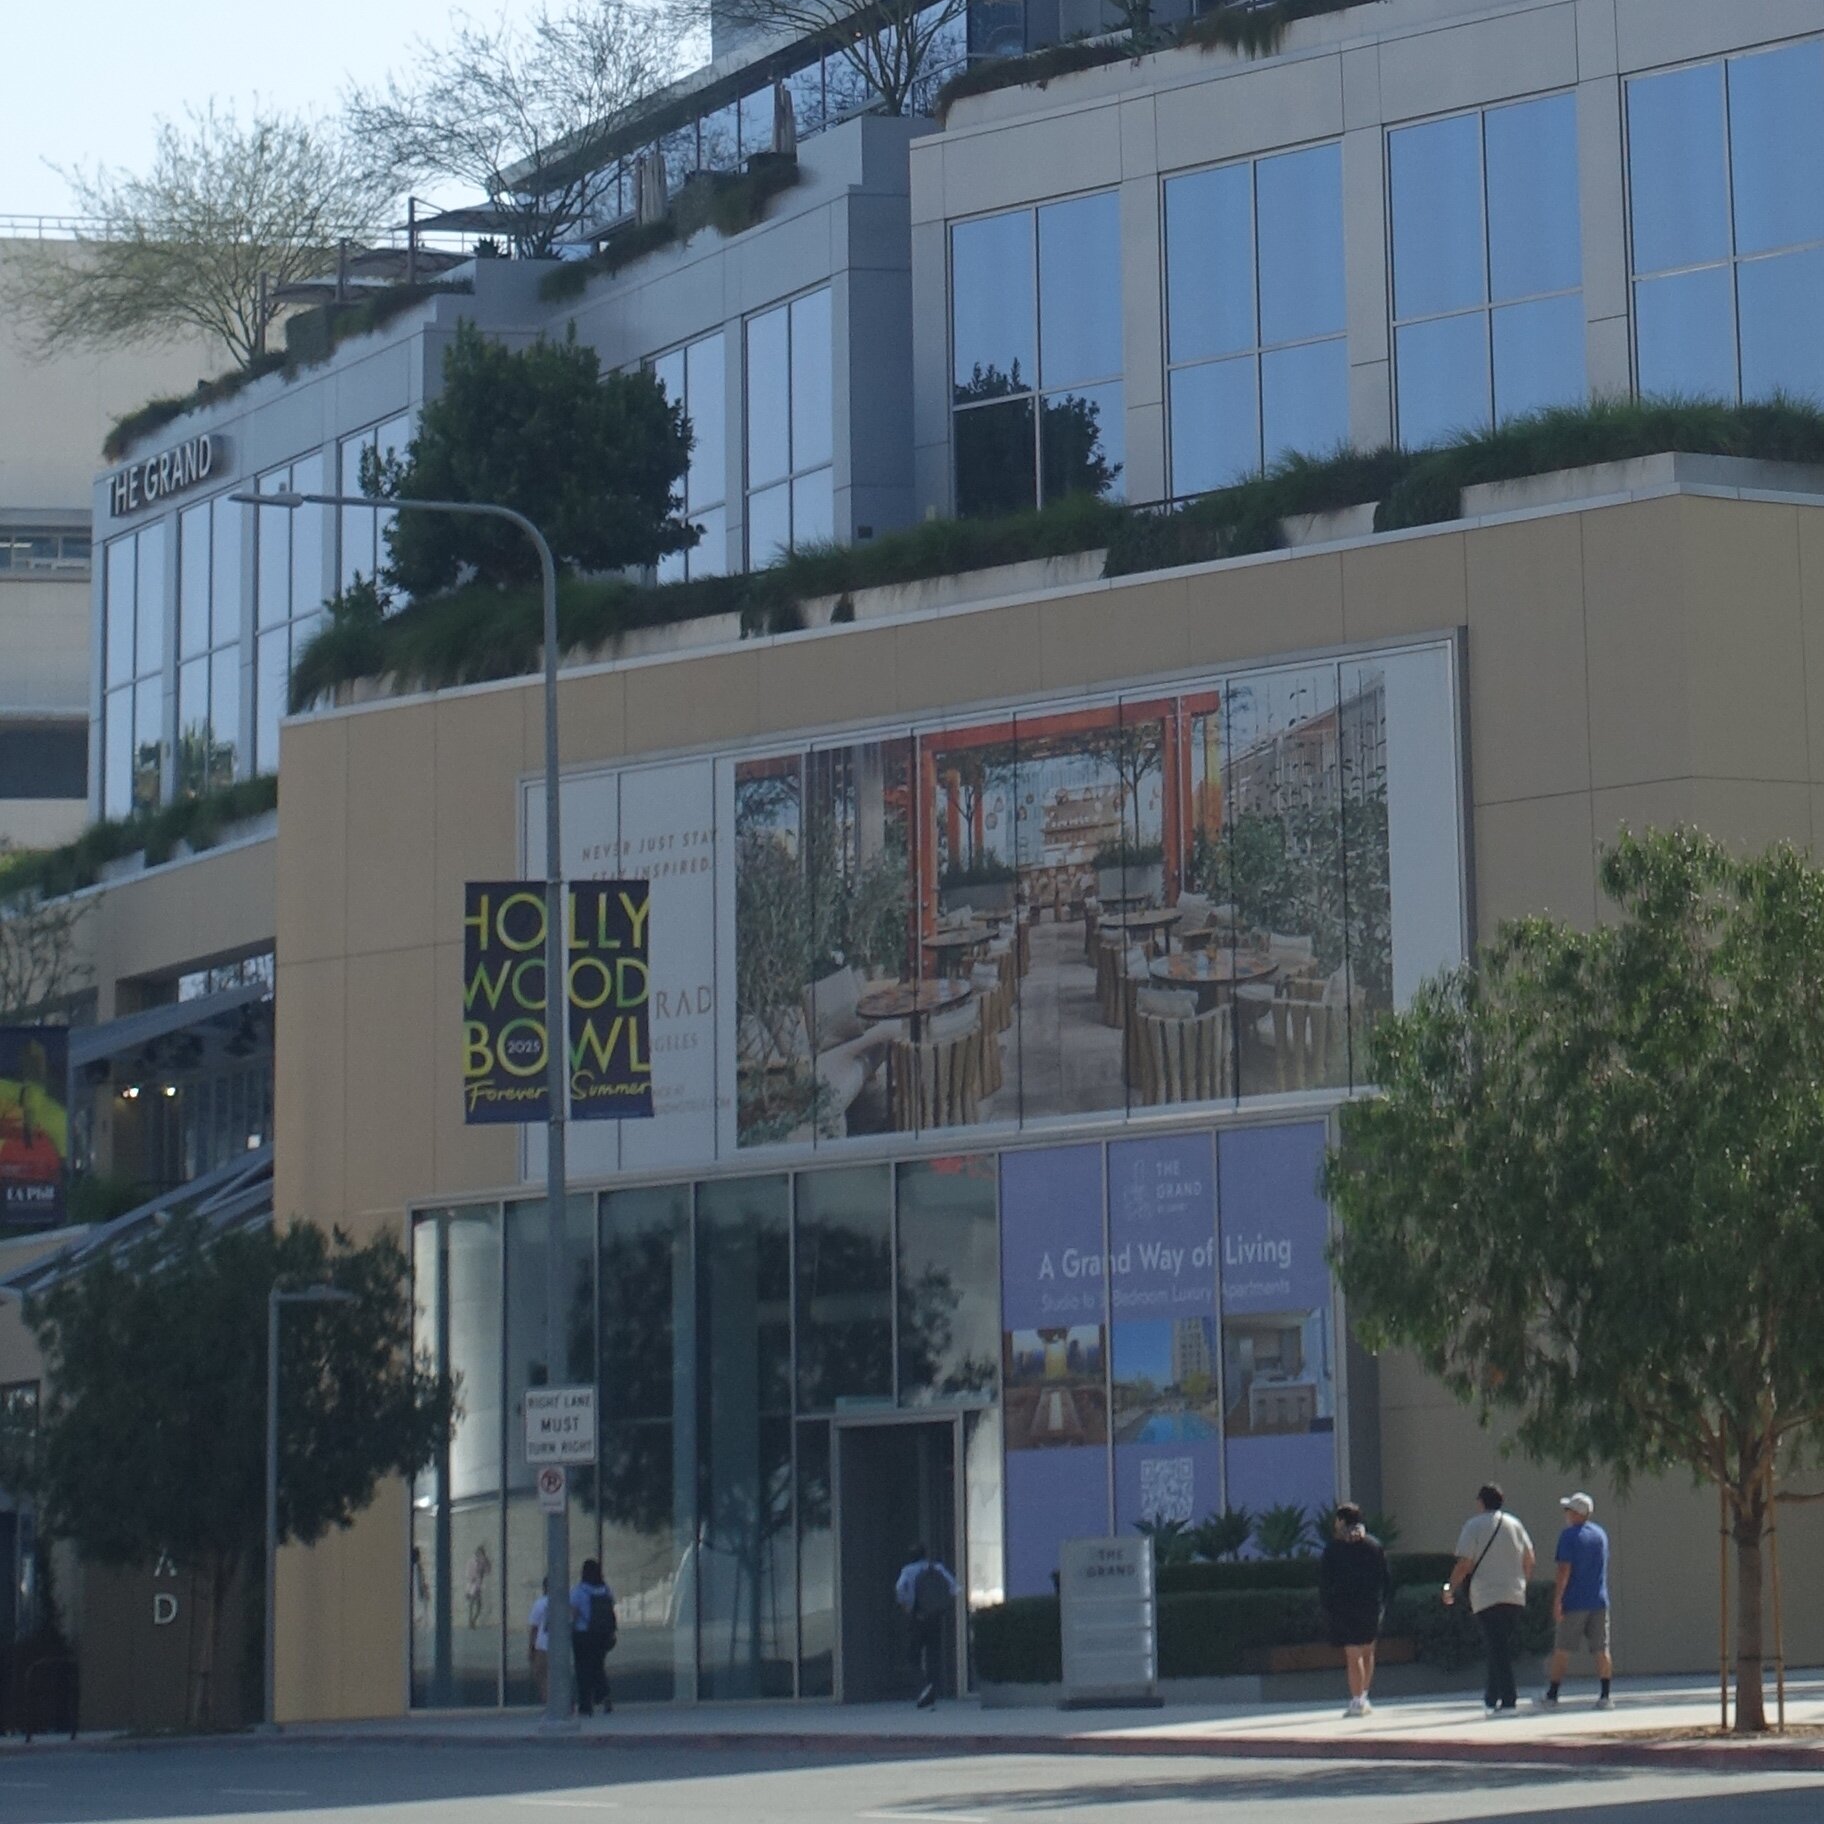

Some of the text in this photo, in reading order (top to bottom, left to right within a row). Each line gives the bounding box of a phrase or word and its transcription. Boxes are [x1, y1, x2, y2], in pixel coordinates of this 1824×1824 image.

[105, 434, 212, 516] THE GRAND
[583, 841, 630, 861] NEVER
[639, 834, 674, 852] JUST
[655, 986, 711, 1019] RAD
[507, 1039, 541, 1054] 2025
[464, 1079, 548, 1113] Forever
[570, 1069, 652, 1100] Summer
[1156, 1181, 1202, 1199] GRAND
[1038, 1234, 1292, 1280] A Grand Way of Living
[541, 1416, 579, 1432] MUST
[1087, 1565, 1136, 1578] GRAND
